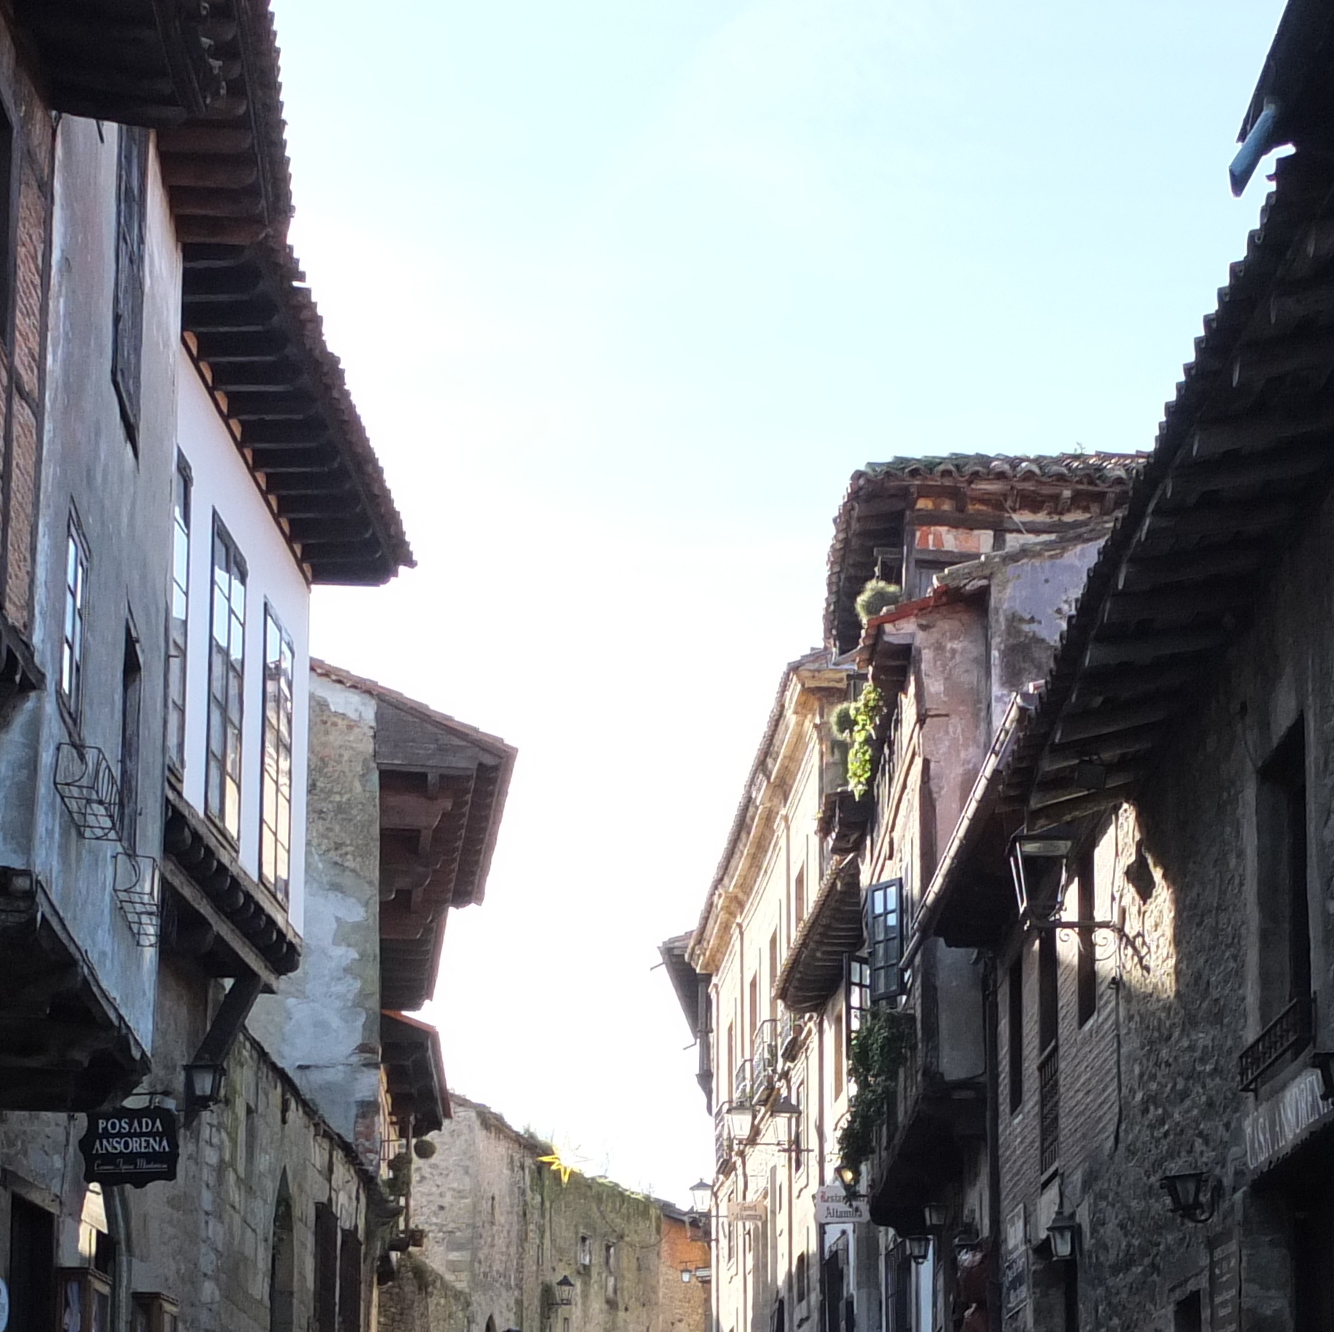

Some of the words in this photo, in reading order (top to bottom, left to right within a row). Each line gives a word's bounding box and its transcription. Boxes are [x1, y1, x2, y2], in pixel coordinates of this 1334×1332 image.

[98, 1117, 163, 1134] POSADA
[92, 1136, 170, 1154] ANSORENA
[1246, 1111, 1273, 1169] CASA
[825, 1205, 863, 1219] Altamira
